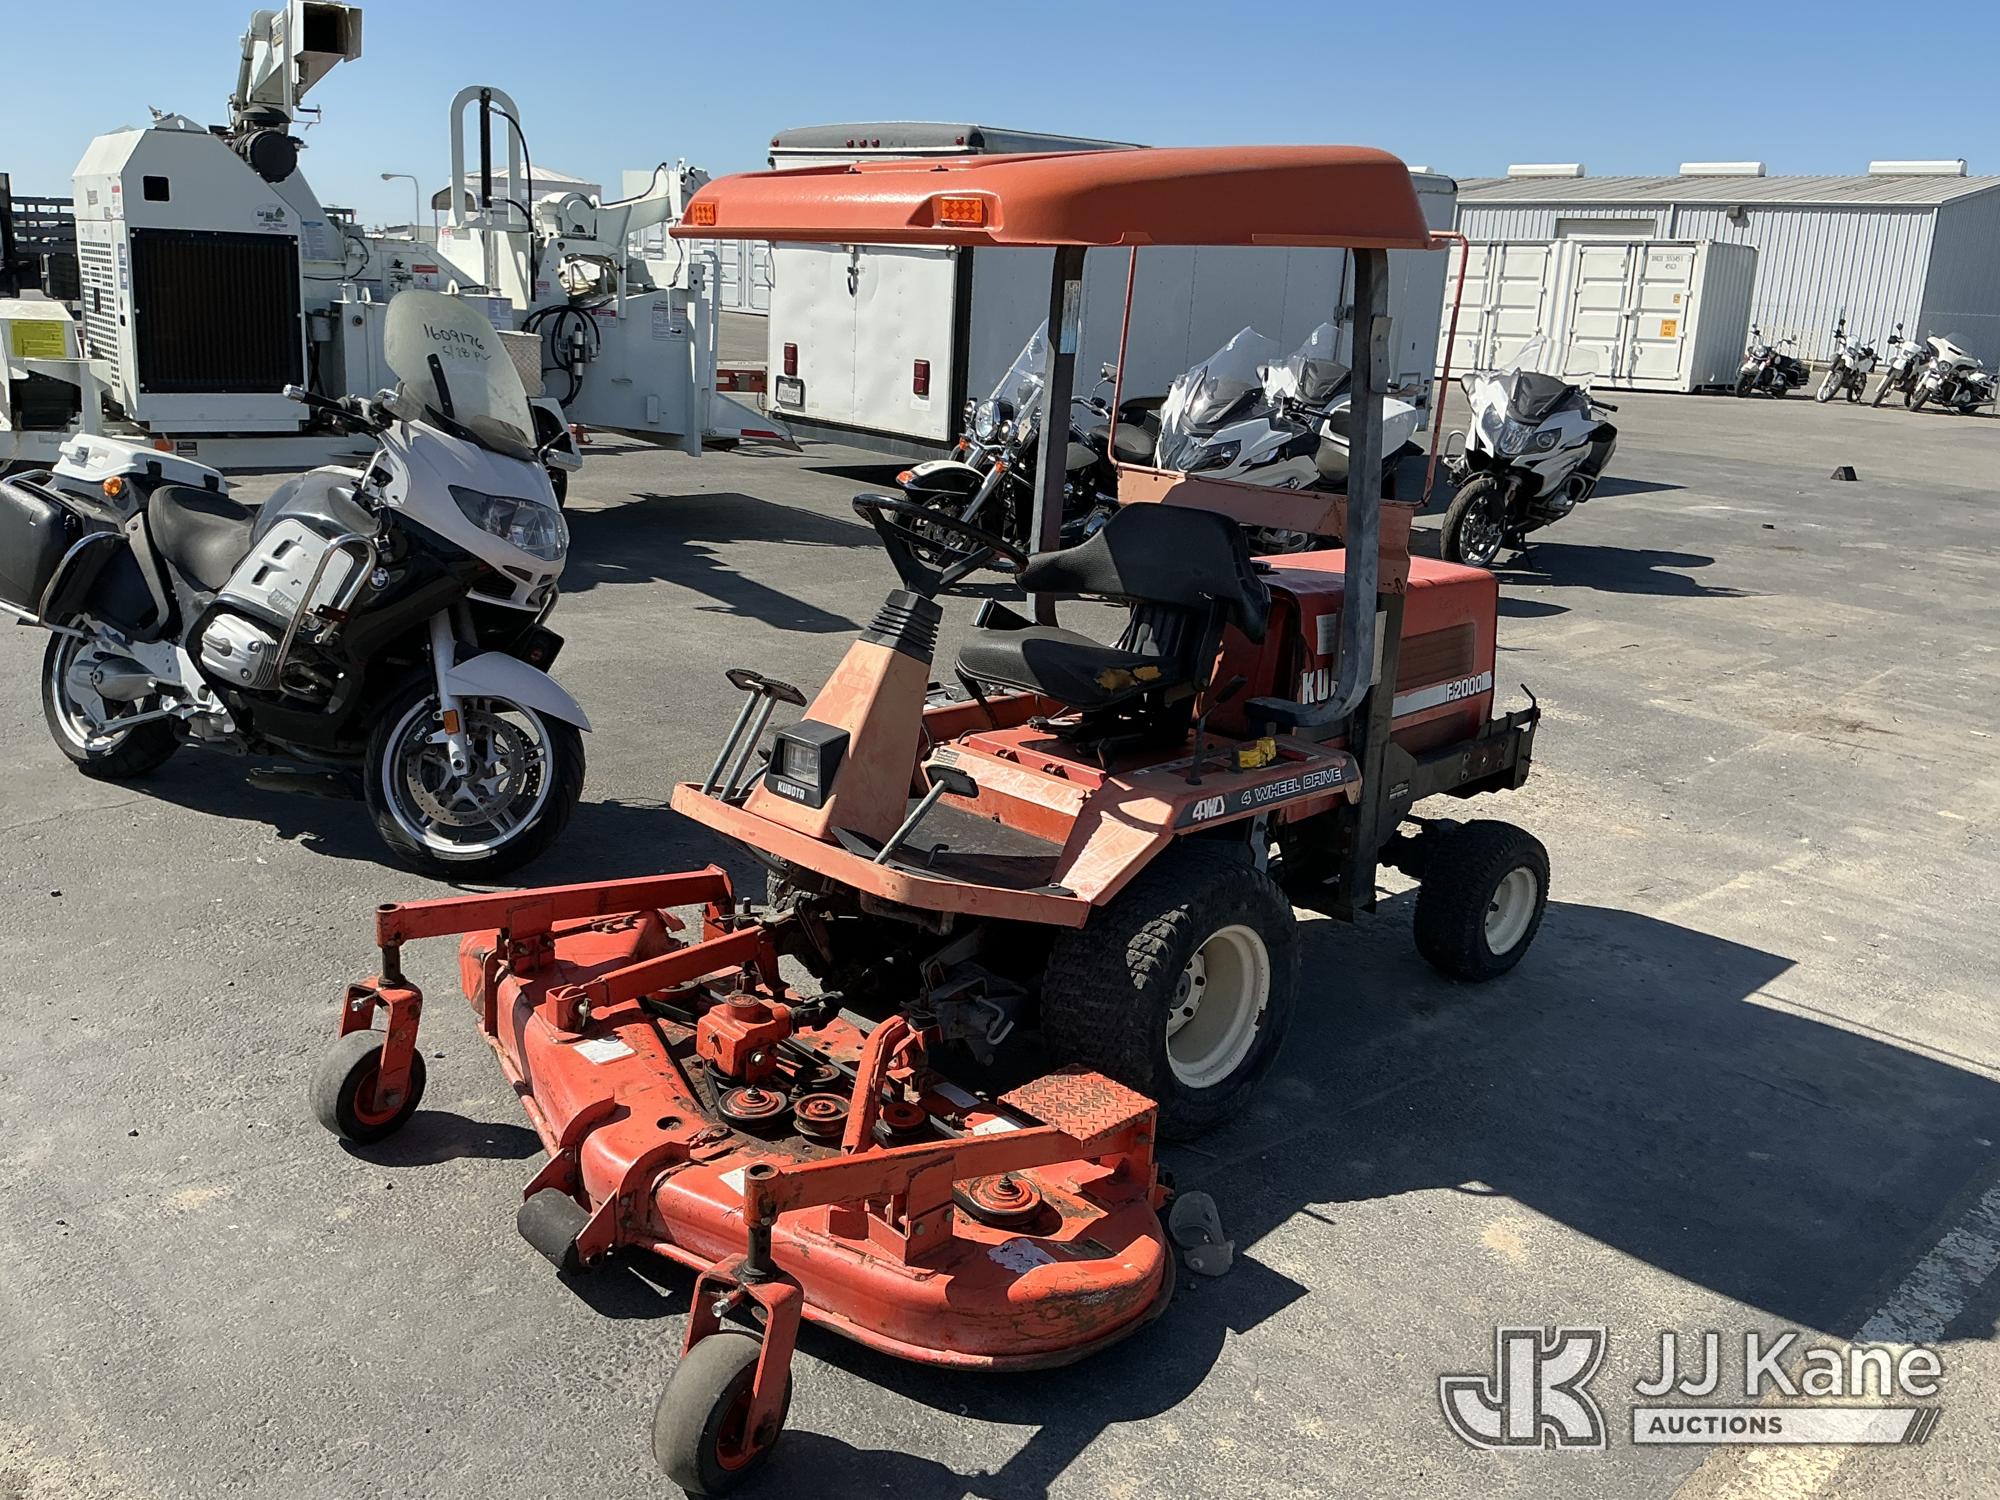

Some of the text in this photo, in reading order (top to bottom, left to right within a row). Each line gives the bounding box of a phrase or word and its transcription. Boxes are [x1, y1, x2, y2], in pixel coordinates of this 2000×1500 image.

[423, 323, 485, 351] 1609176
[1446, 675, 1482, 702] F2000
[778, 781, 805, 800] KUBOTA
[1241, 767, 1342, 805] 4 WHEEL DRIVE
[1192, 795, 1226, 821] 4WD
